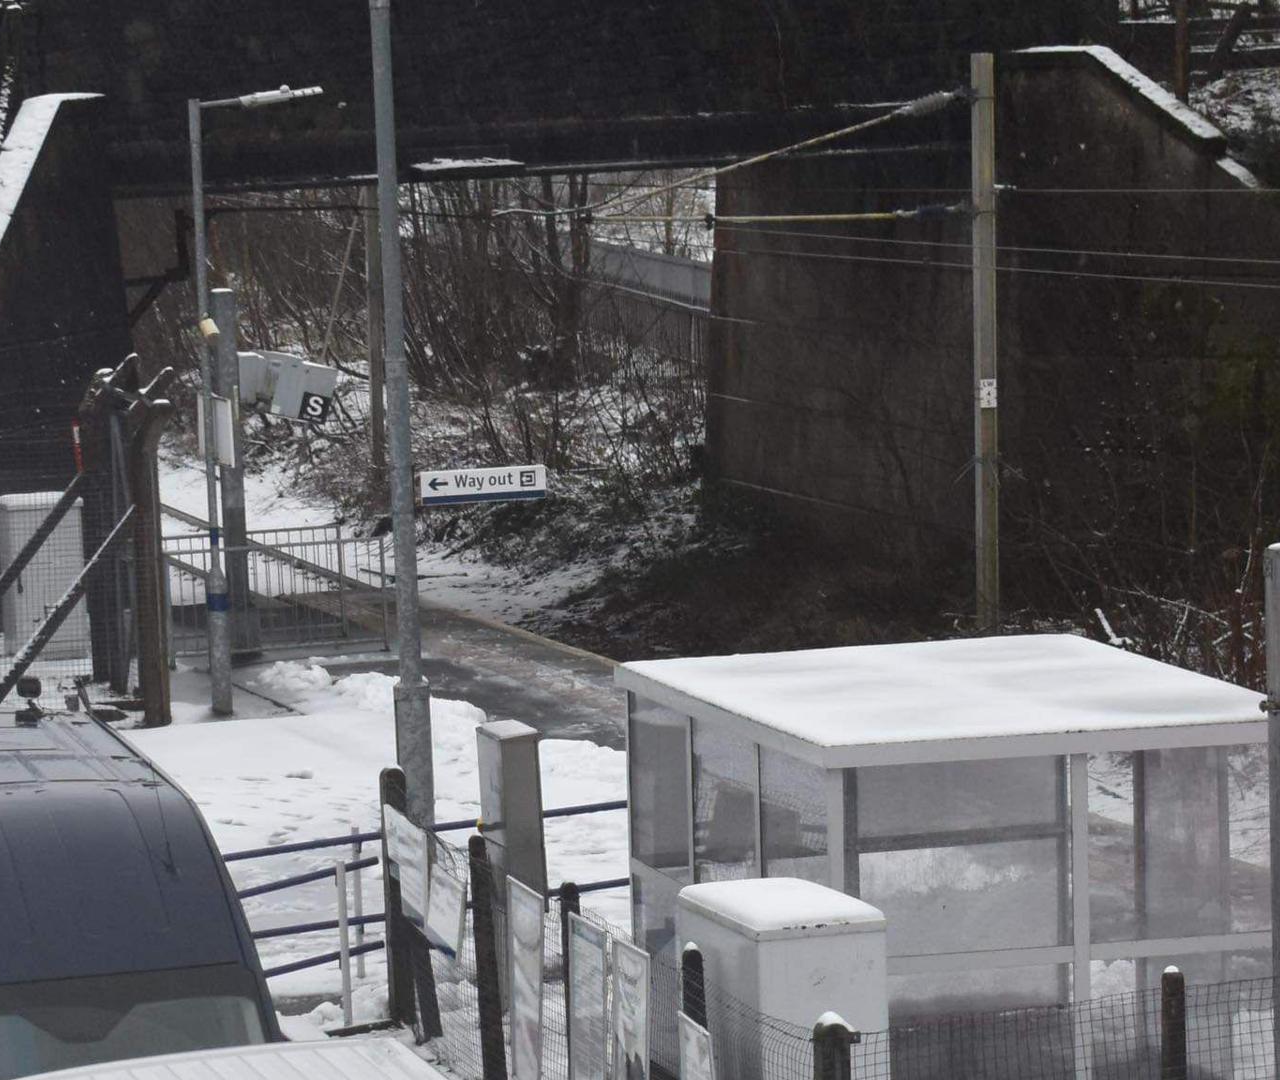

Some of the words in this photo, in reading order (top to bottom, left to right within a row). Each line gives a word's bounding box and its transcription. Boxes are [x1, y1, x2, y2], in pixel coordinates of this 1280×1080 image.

[306, 396, 324, 416] S
[454, 474, 485, 491] Way
[488, 472, 514, 487] out
